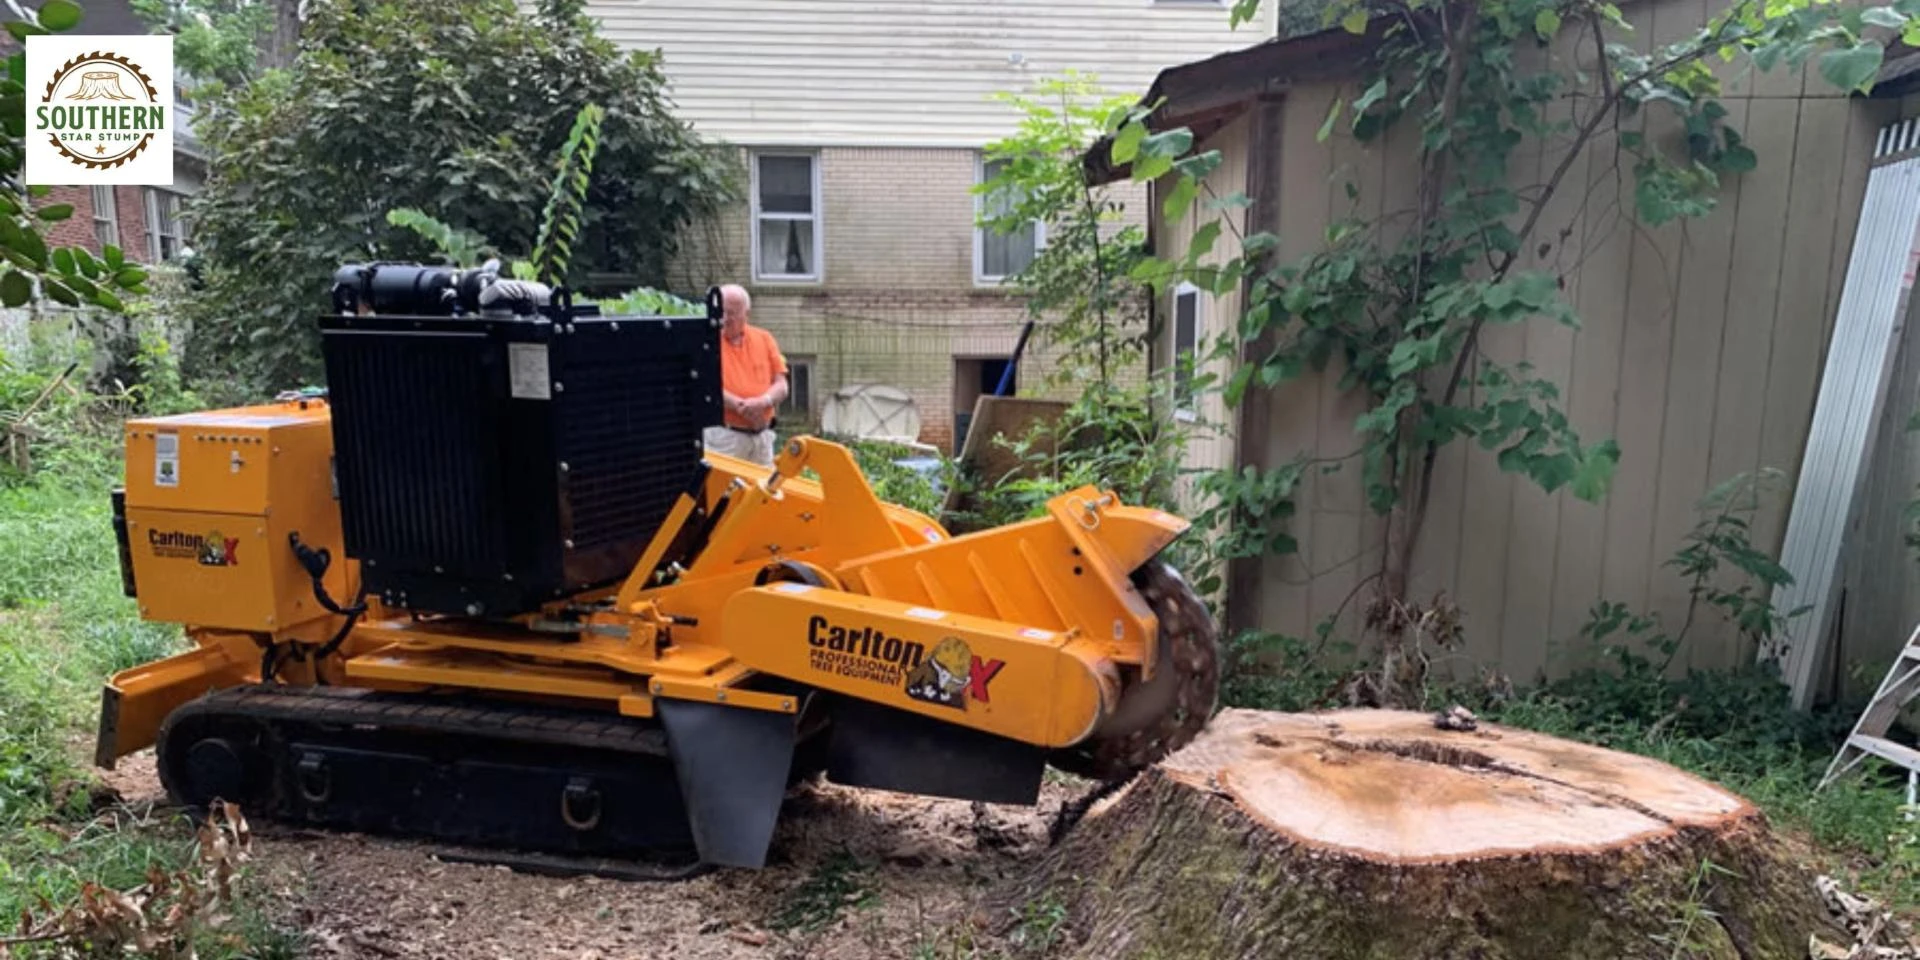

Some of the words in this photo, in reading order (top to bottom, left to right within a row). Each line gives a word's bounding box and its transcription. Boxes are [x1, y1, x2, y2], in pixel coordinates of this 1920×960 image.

[148, 528, 203, 550] Carlton
[808, 616, 924, 668] Carlton
[810, 660, 834, 673] TREE
[836, 665, 900, 686] EQUIPMENT
